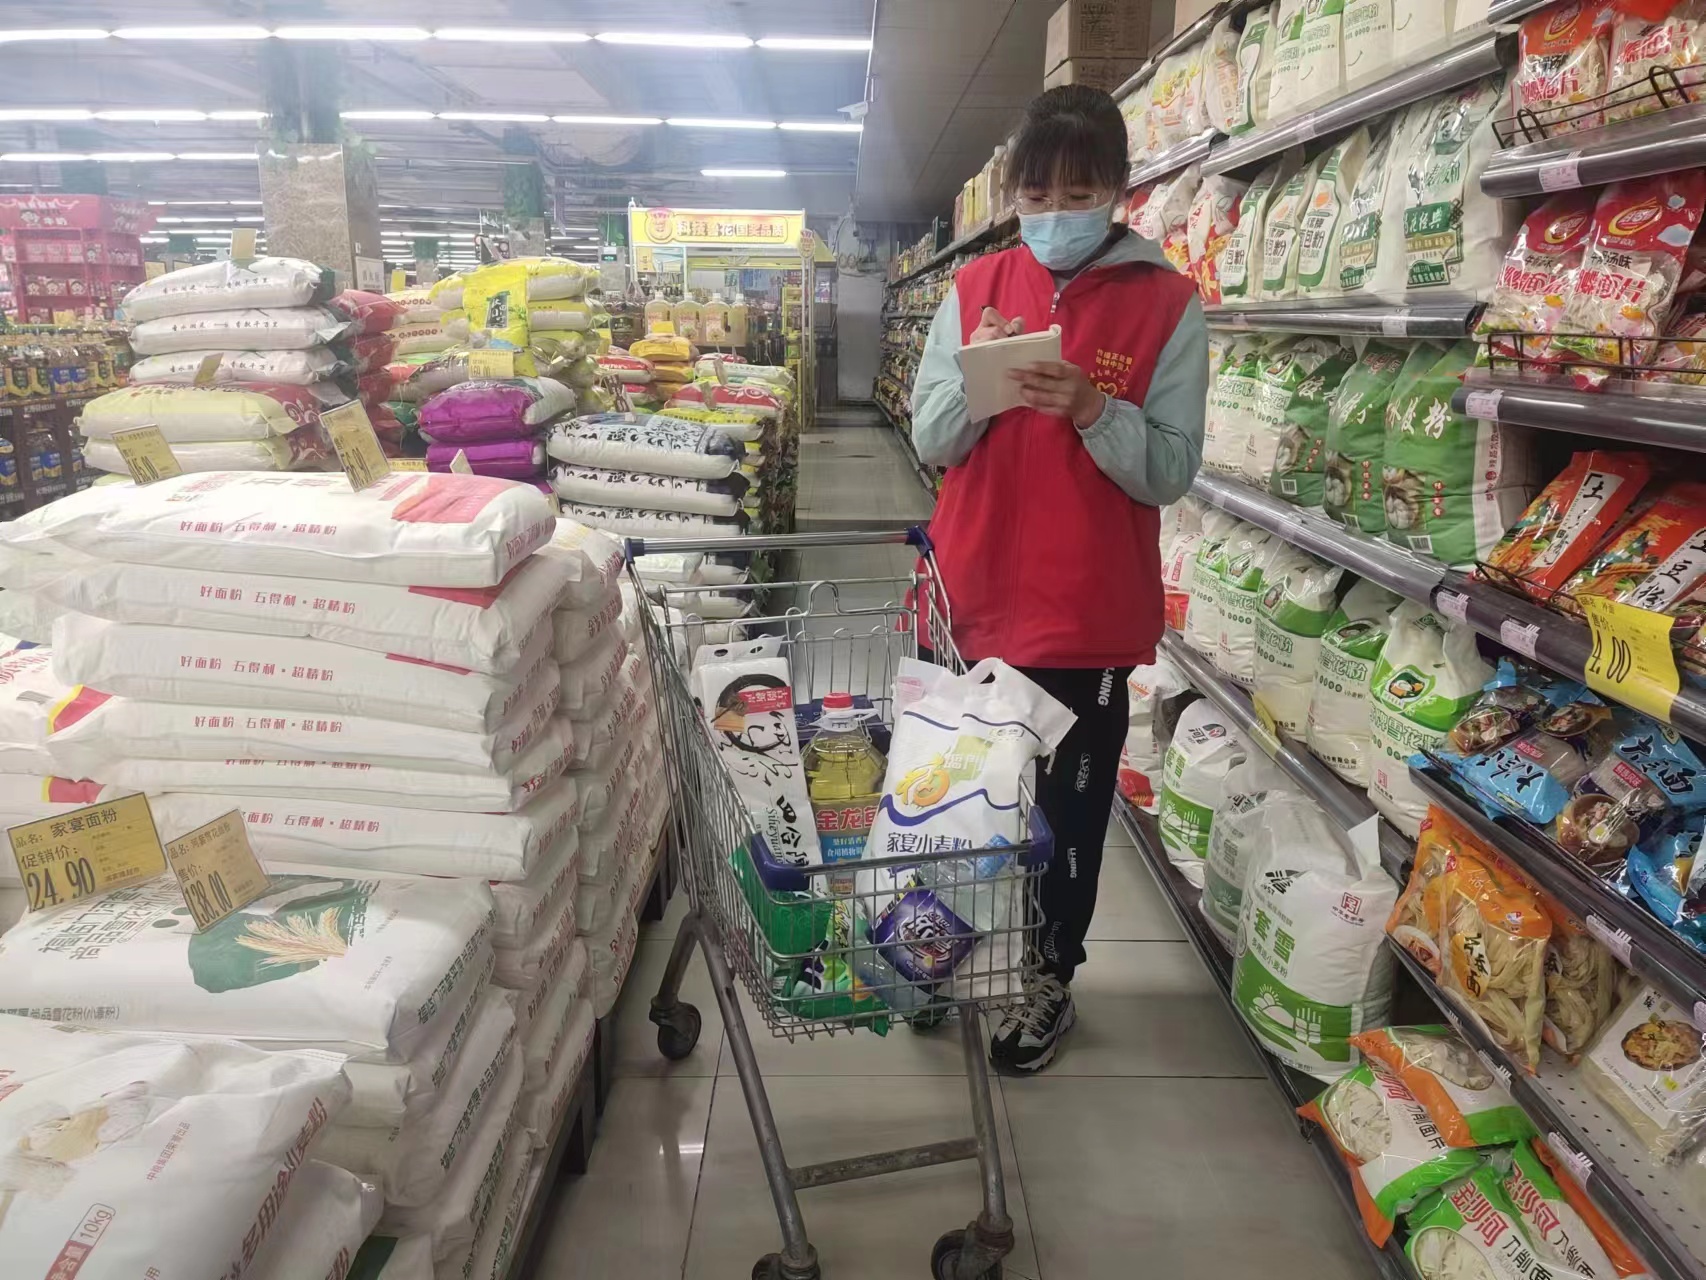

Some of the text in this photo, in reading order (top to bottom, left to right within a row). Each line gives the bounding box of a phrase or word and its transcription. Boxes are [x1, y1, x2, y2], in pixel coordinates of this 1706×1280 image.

[180, 521, 224, 533] 好面粉
[200, 585, 242, 601] 好面粉
[180, 656, 222, 670] 好面粉
[194, 716, 235, 729] 好面粉
[51, 808, 118, 837] 家宴面粉
[15, 834, 44, 848] 品名:
[887, 832, 973, 853] 家宴小麦粉
[20, 845, 79, 870] 促销价:
[27, 857, 96, 913] 24.90
[185, 870, 233, 927] 138.00
[80, 1209, 113, 1239] 10kg
[1450, 1178, 1509, 1248] 金沙河
